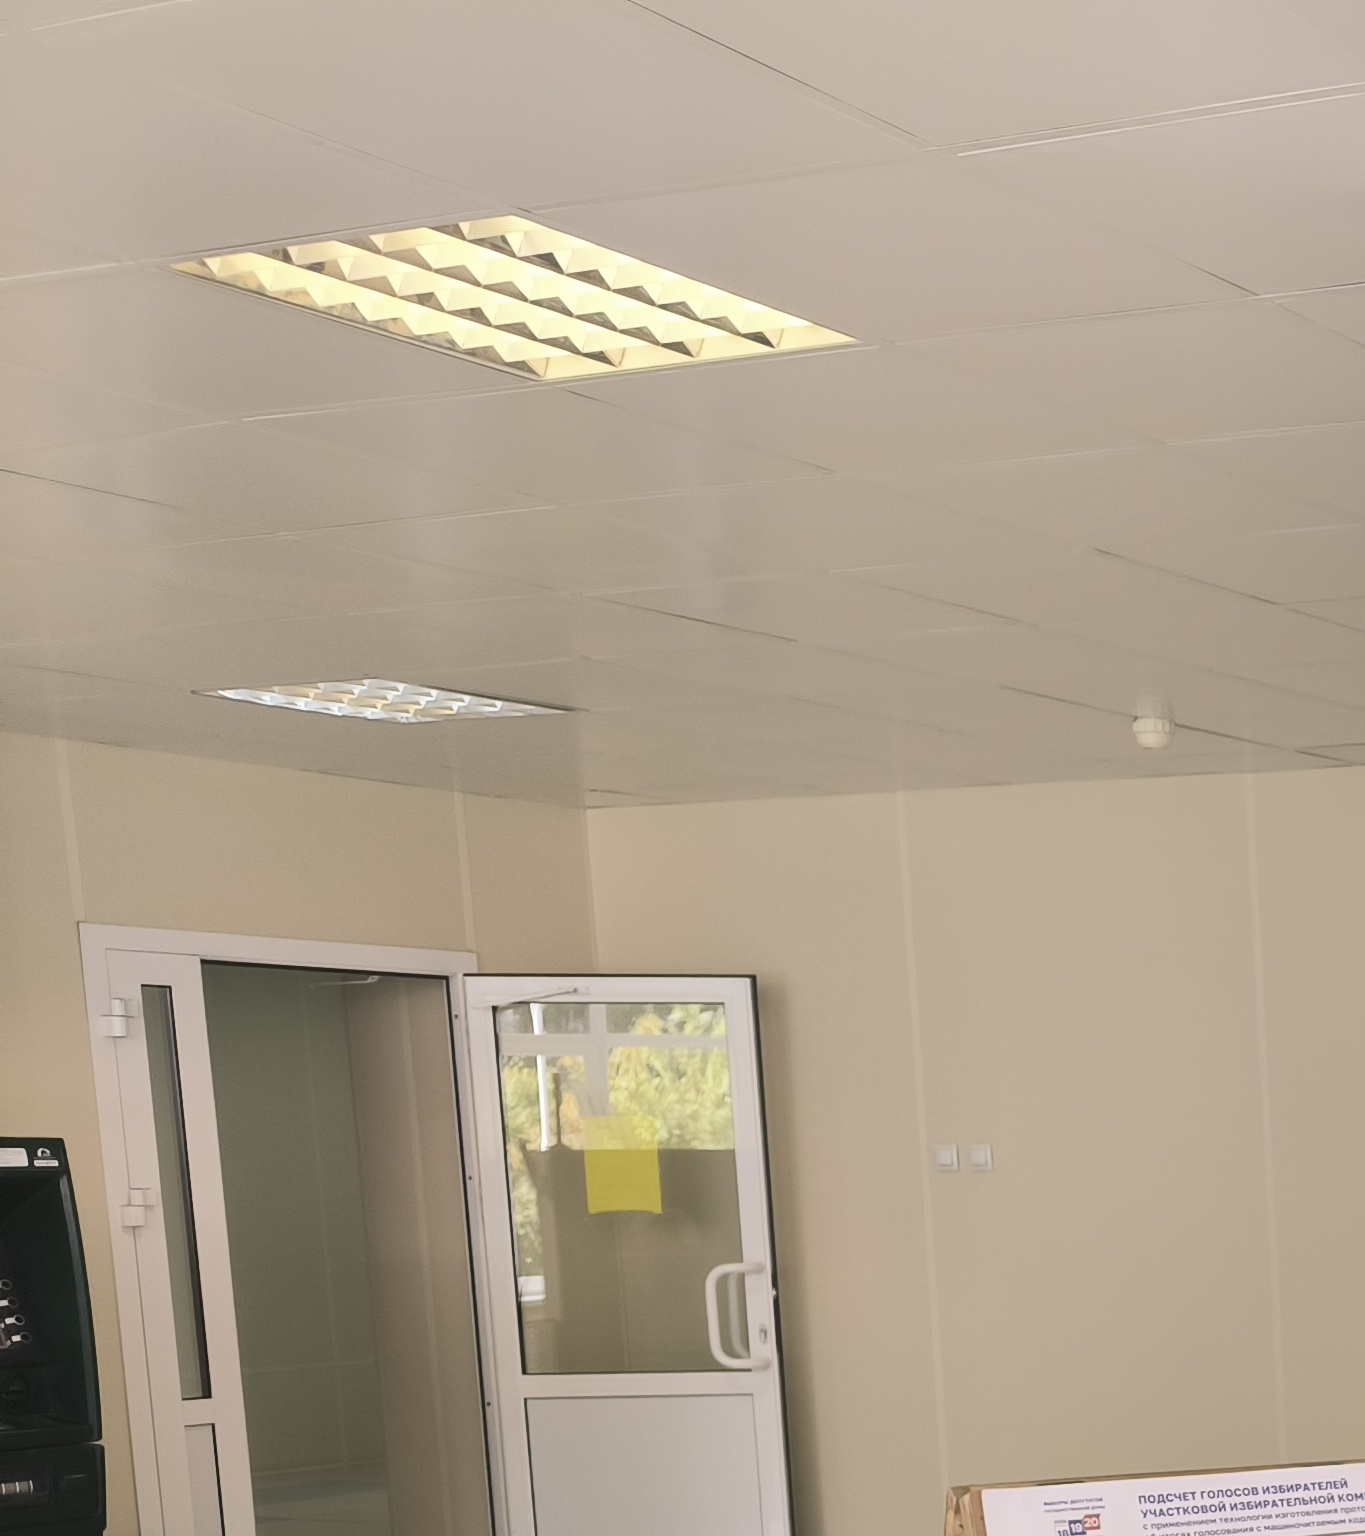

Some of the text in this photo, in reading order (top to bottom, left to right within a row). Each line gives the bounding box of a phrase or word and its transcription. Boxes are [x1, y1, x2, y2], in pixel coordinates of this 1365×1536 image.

[1138, 1477, 1349, 1505] ПОДСЧЕТ ГОЛОСОВ ИЗБИРАТЕЛЕЙ
[1140, 1502, 1227, 1519] УЧАСТКОВОЙ
[1229, 1491, 1336, 1511] ИЗБИРАТЕЛЬНОЙ
[1069, 1522, 1083, 1533] 19
[1083, 1516, 1099, 1528] 20
